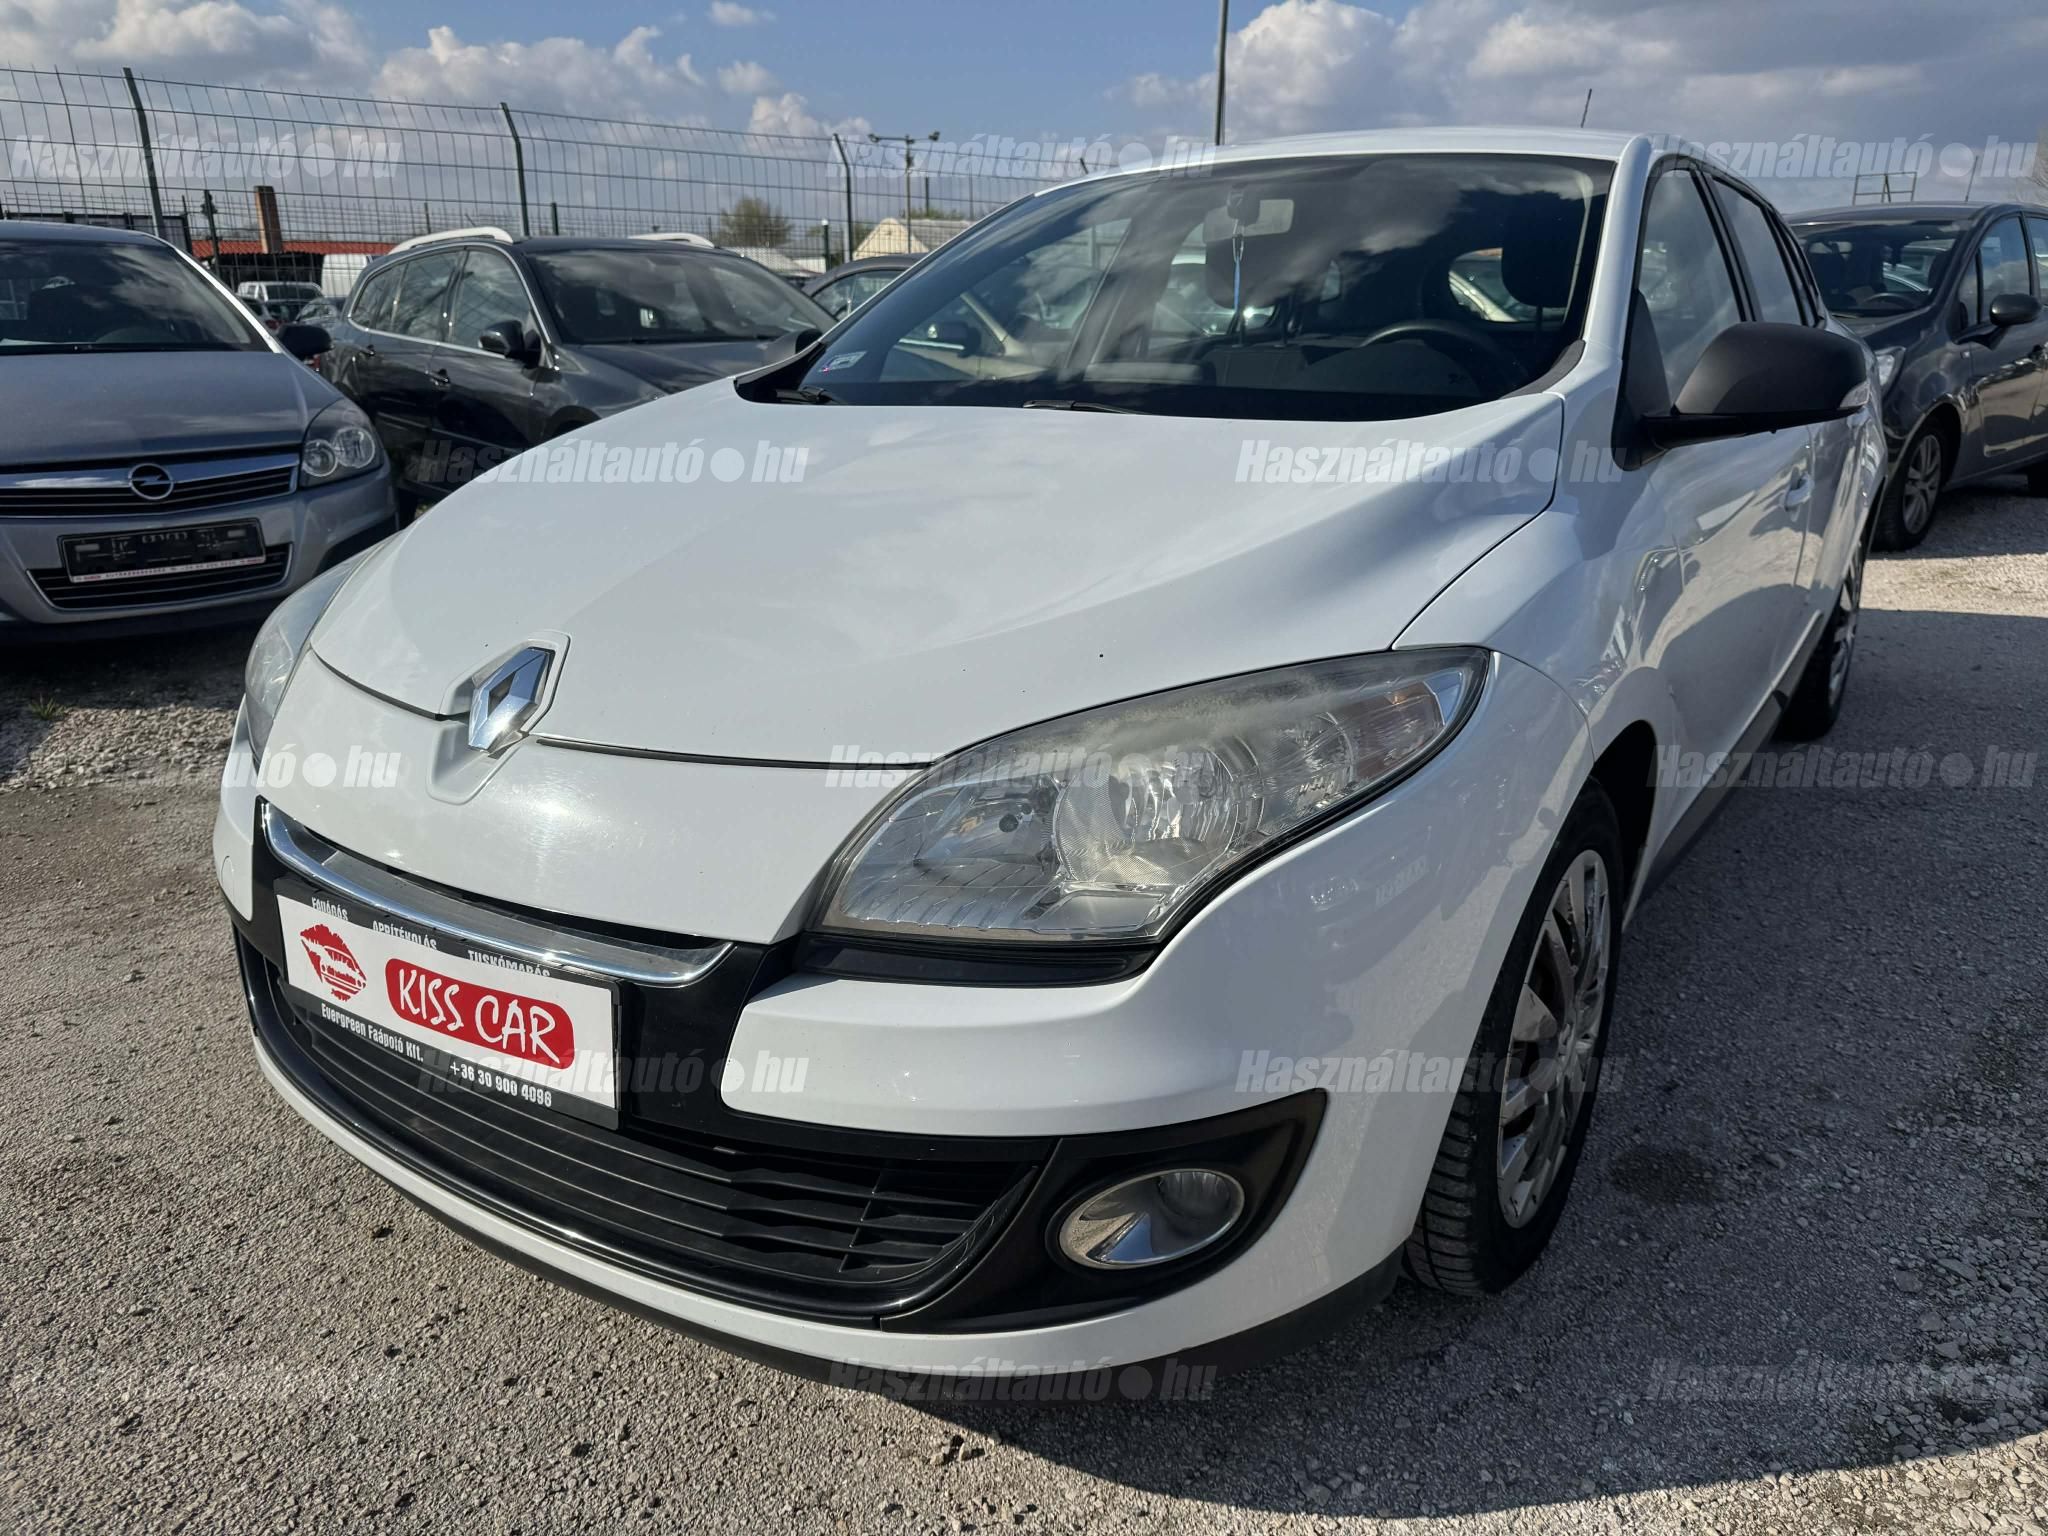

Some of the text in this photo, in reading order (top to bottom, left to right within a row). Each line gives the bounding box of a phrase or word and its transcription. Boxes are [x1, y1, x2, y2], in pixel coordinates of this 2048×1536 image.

[321, 1002, 367, 1037] Evergreen
[398, 968, 560, 1064] KISS CAR
[477, 1069, 492, 1088] 30
[495, 1075, 518, 1097] 900
